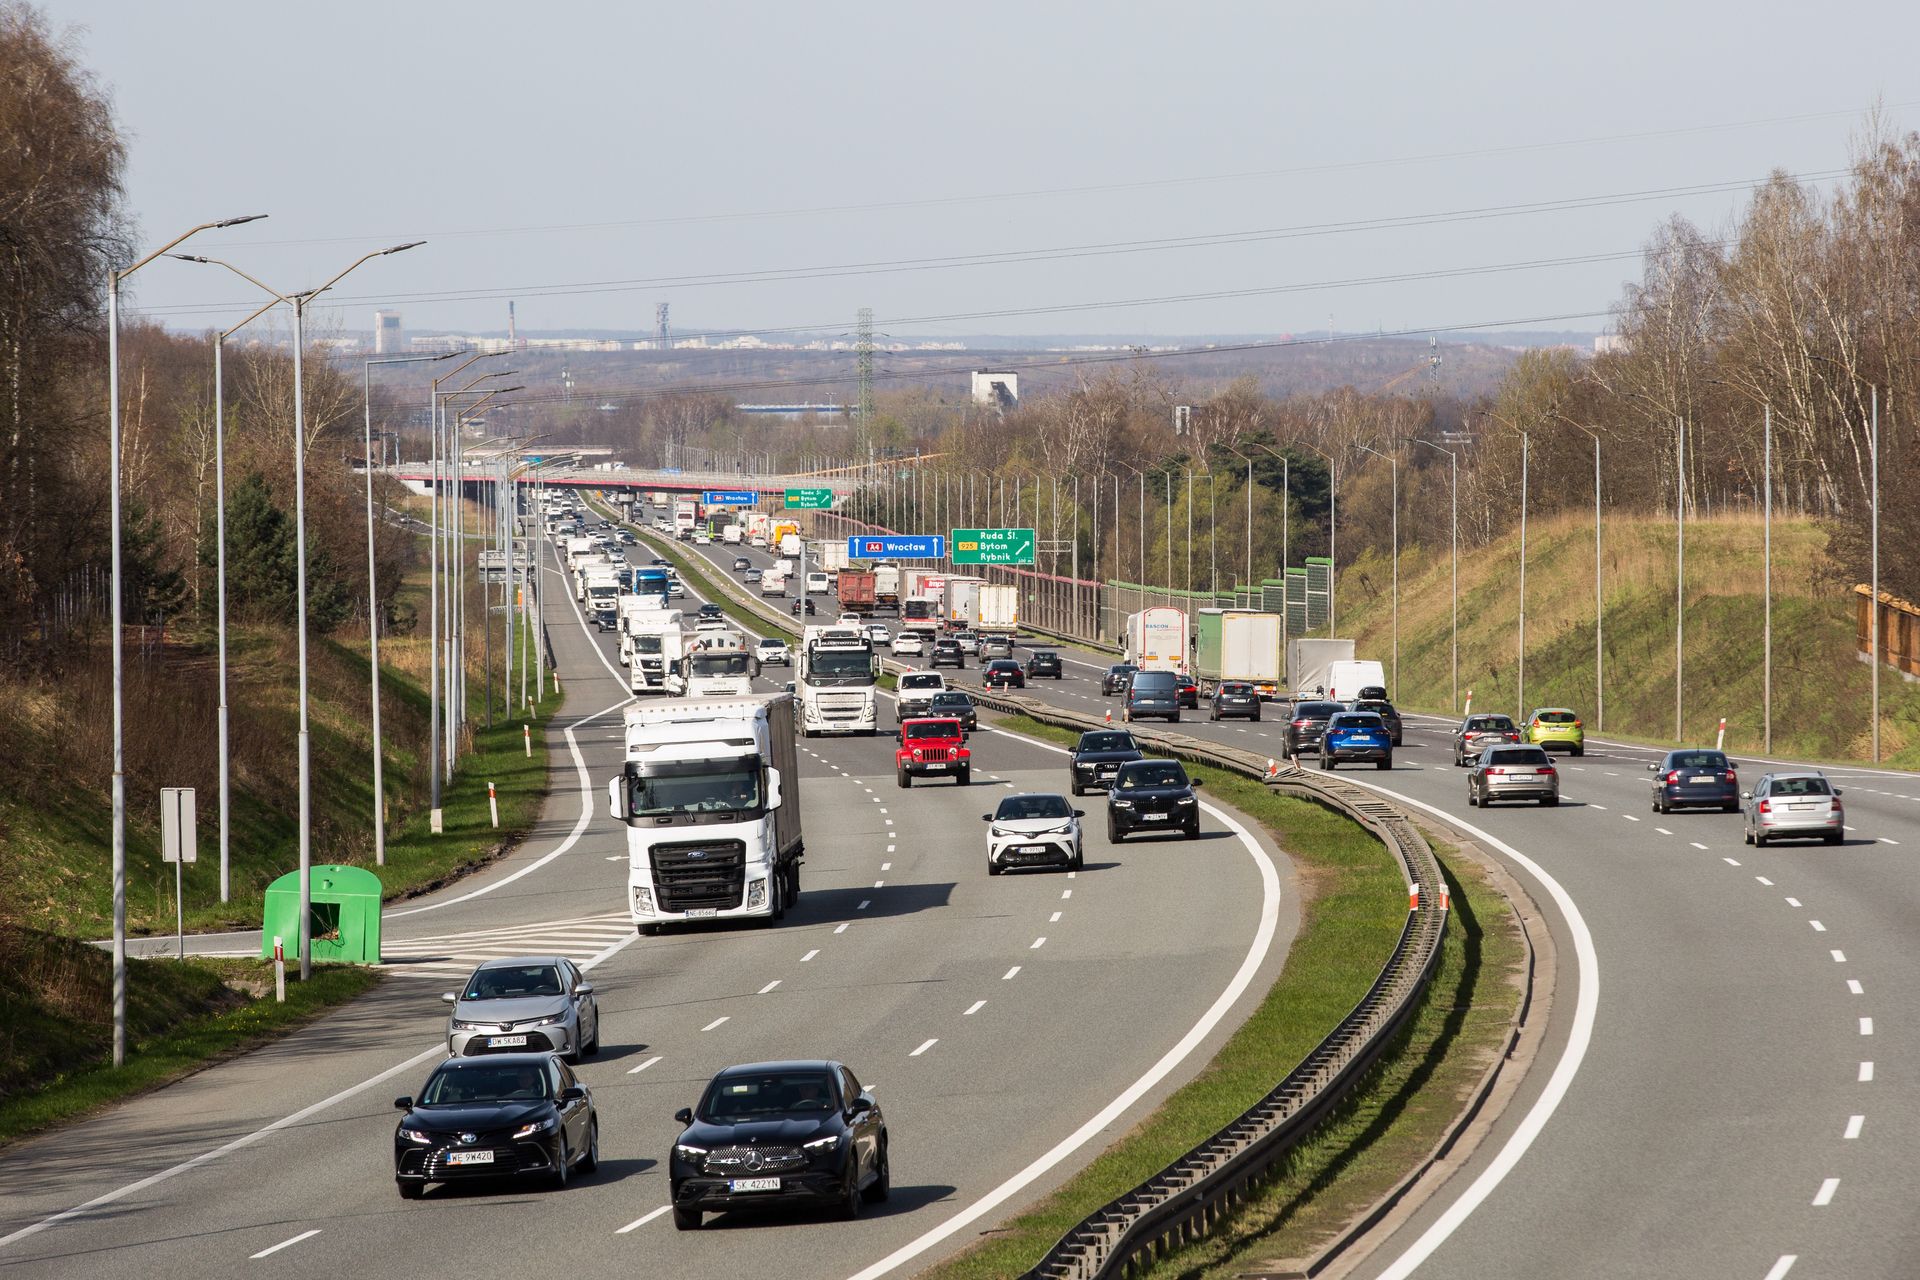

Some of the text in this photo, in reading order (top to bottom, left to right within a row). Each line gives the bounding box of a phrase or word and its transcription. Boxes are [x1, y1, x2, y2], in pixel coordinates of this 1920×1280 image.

[980, 530, 1018, 540] Ruda Śl.
[887, 543, 926, 551] Wrocław
[980, 542, 1008, 551] Bytom
[980, 553, 1011, 562] Rybnik
[451, 1152, 492, 1162] WE 9W420
[736, 1179, 778, 1190] SK 422YN
